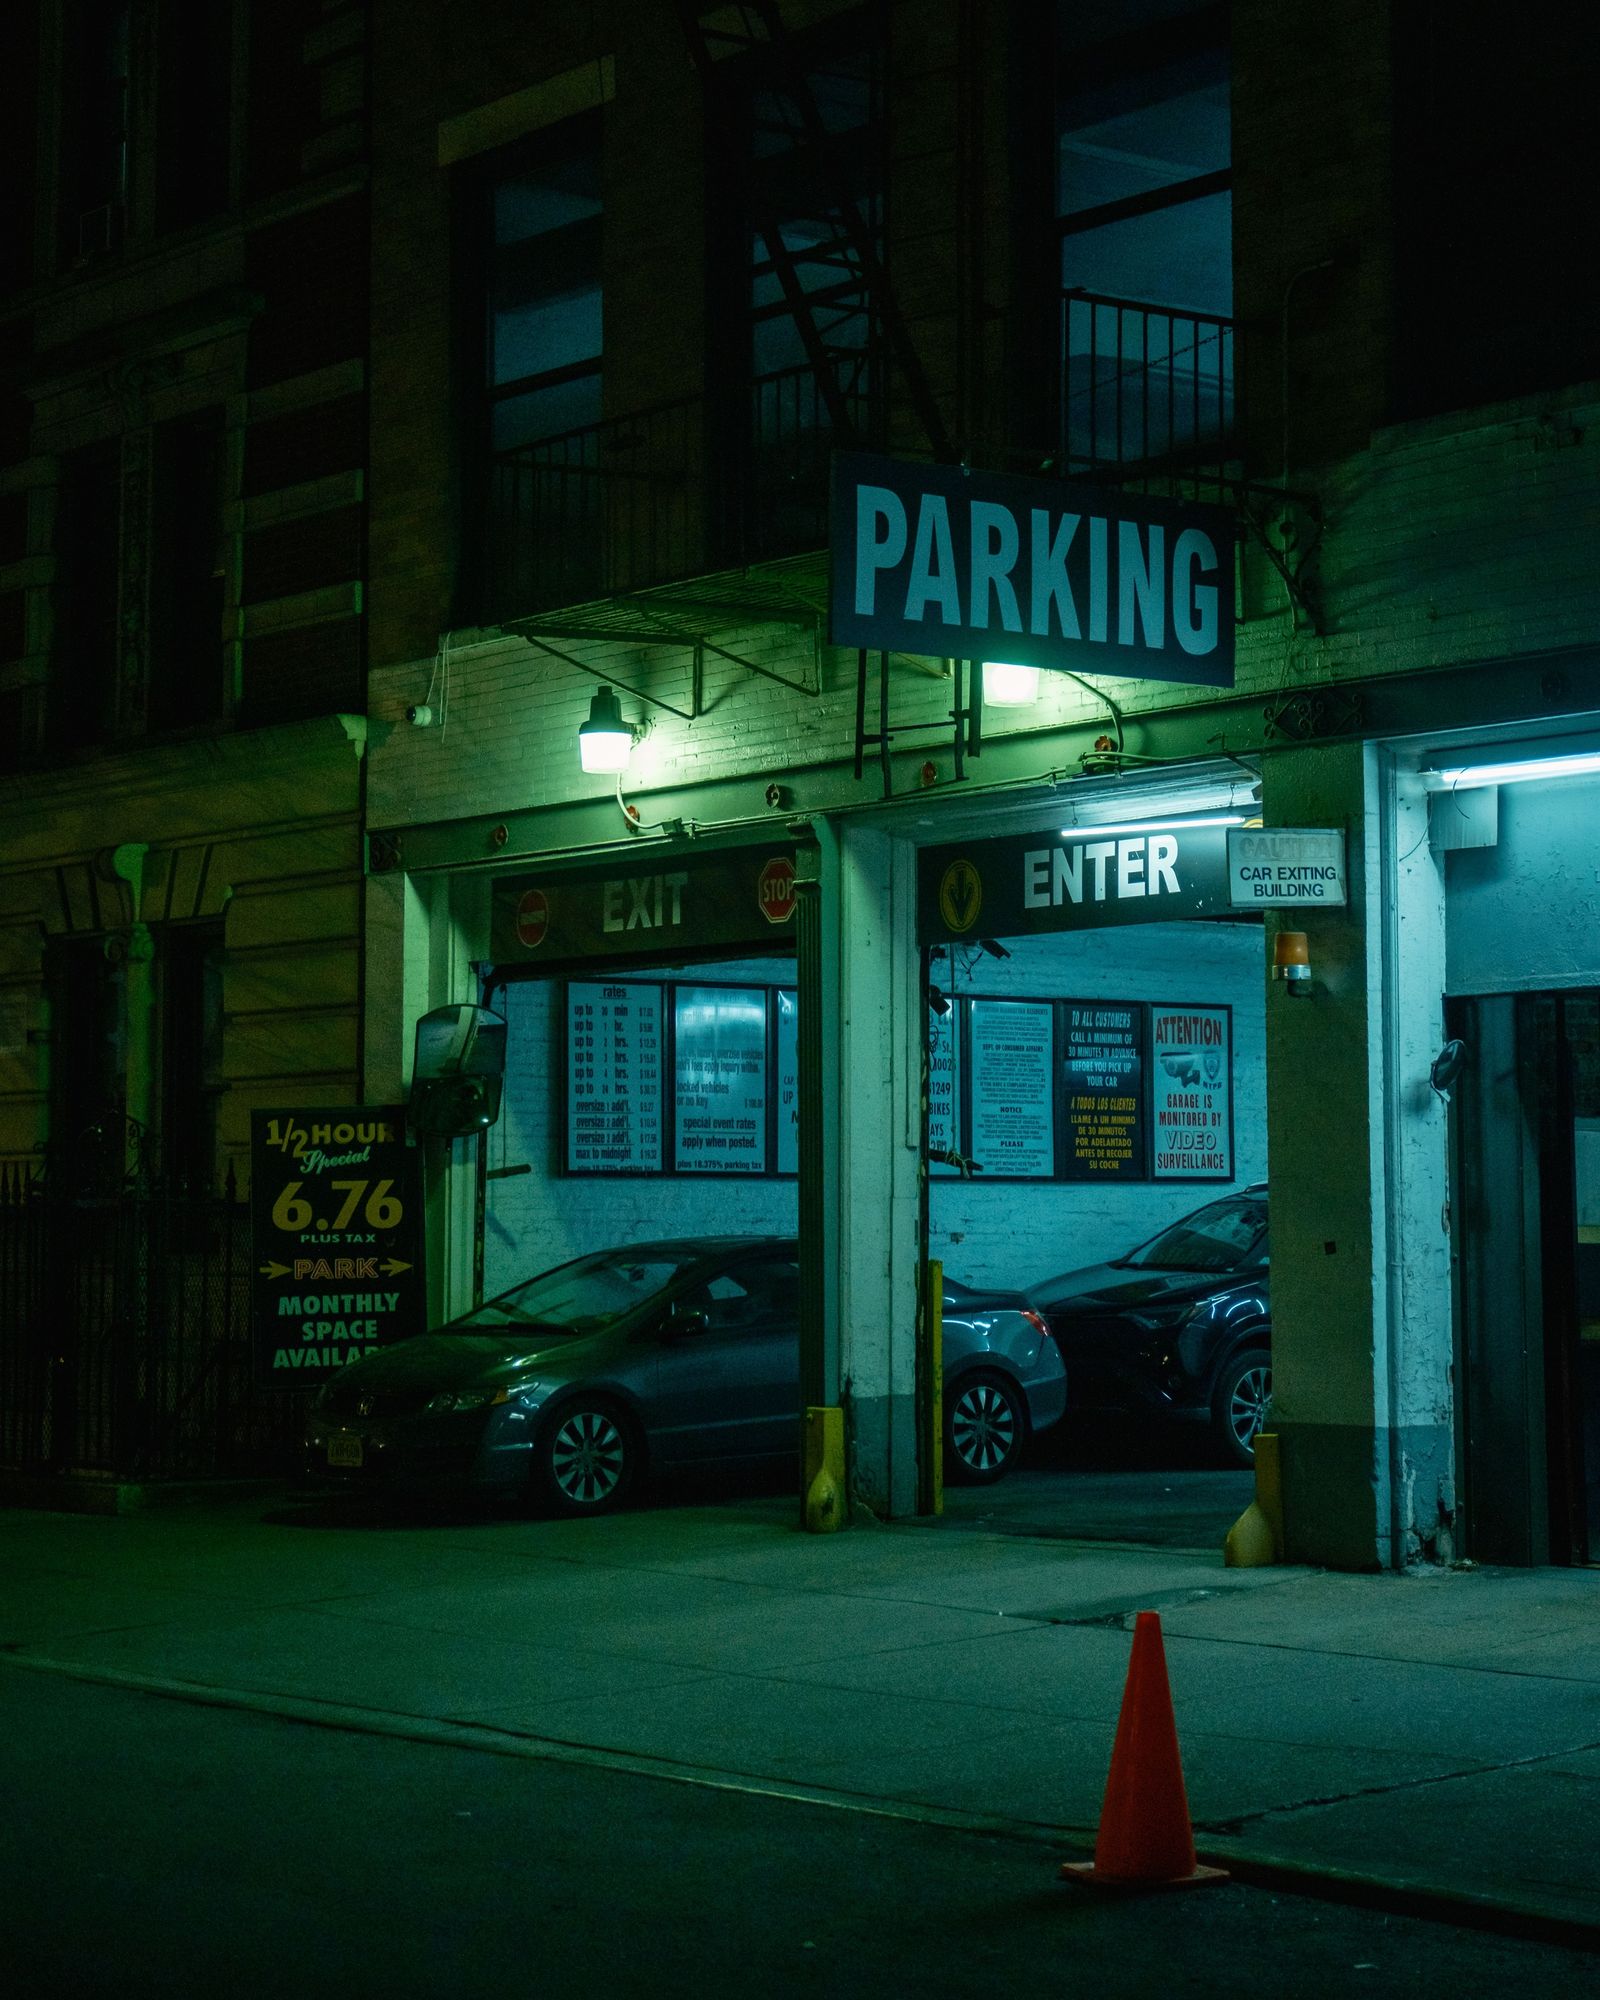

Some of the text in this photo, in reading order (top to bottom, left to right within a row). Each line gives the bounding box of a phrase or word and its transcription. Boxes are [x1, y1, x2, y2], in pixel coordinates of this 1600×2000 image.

[855, 484, 1219, 656] PARKING
[1024, 834, 1181, 909] ENTER
[1240, 866, 1336, 880] CAR EXITING
[763, 877, 794, 903] STOP
[1253, 883, 1324, 897] BUILDING
[603, 871, 688, 933] EXIT
[603, 985, 627, 998] rates
[614, 1003, 628, 1016] min
[1072, 1011, 1131, 1028] TO ALL CUSTOMERS
[1156, 1016, 1221, 1045] ATTENTION
[1071, 1032, 1132, 1045] CALL A MINIMUM OF
[1068, 1046, 1136, 1059] 30 MINUTES IN ADVANCE
[1072, 1061, 1131, 1073] BEFORE YOU PICK UP
[1087, 1075, 1118, 1087] YOUR CAR
[929, 1082, 951, 1095] 1249
[783, 1090, 794, 1104] UP
[1077, 1097, 1095, 1111] TODOS
[1097, 1097, 1108, 1111] LOS
[1110, 1097, 1136, 1111] CLIENTES
[1167, 1094, 1212, 1109] GARAGE IS
[929, 1103, 950, 1115] BIKES
[683, 1116, 756, 1130] special event rates
[1071, 1115, 1091, 1124] LLAME
[1093, 1115, 1098, 1124] A
[1159, 1112, 1221, 1126] MONITORED BY
[930, 1124, 944, 1136] AYS
[1078, 1126, 1126, 1135] DE 30 MINUTOS
[265, 1117, 395, 1158] 1/2 HOUR
[682, 1136, 703, 1150] apply
[706, 1136, 726, 1148] when
[1075, 1137, 1132, 1146] POR ADELANTADO
[1164, 1130, 1216, 1150] VIDEO
[300, 1145, 371, 1175] Special
[601, 1147, 631, 1161] midnight
[1076, 1149, 1095, 1157] ANTES
[1097, 1149, 1105, 1158] DE
[1089, 1161, 1119, 1169] SU COCHE
[1158, 1153, 1224, 1169] SURVEILLANCE
[272, 1179, 404, 1232] 6.76
[300, 1233, 376, 1244] PLUS TAX
[294, 1257, 379, 1280] PARK
[278, 1292, 400, 1316] MONTHLY
[302, 1319, 378, 1342] SPACE
[273, 1345, 381, 1369] AVAILA
